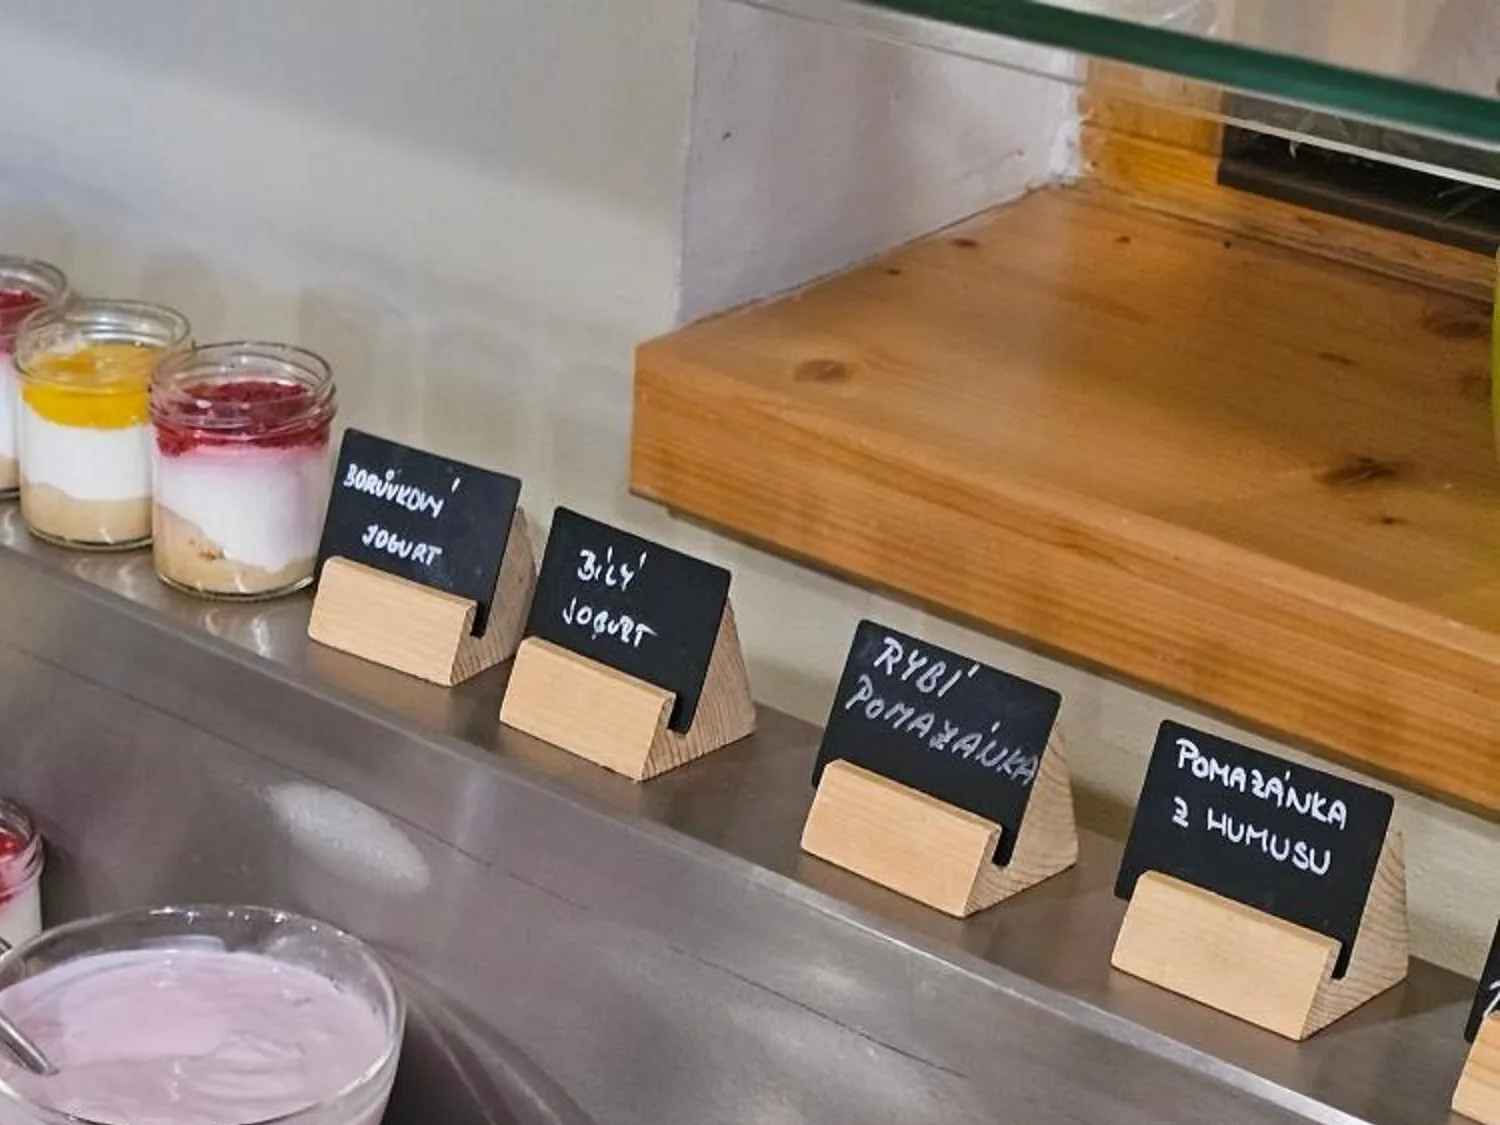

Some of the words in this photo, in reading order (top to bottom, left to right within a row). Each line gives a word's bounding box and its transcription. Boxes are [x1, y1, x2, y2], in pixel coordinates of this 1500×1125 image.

[361, 523, 443, 566] JOGURT
[577, 545, 647, 592] BÍLÝ
[562, 596, 658, 647] JOGURT
[873, 636, 980, 697] RYBÍ
[1176, 738, 1347, 830] POMAZÁNKA
[1207, 807, 1331, 875] HUMUSU
